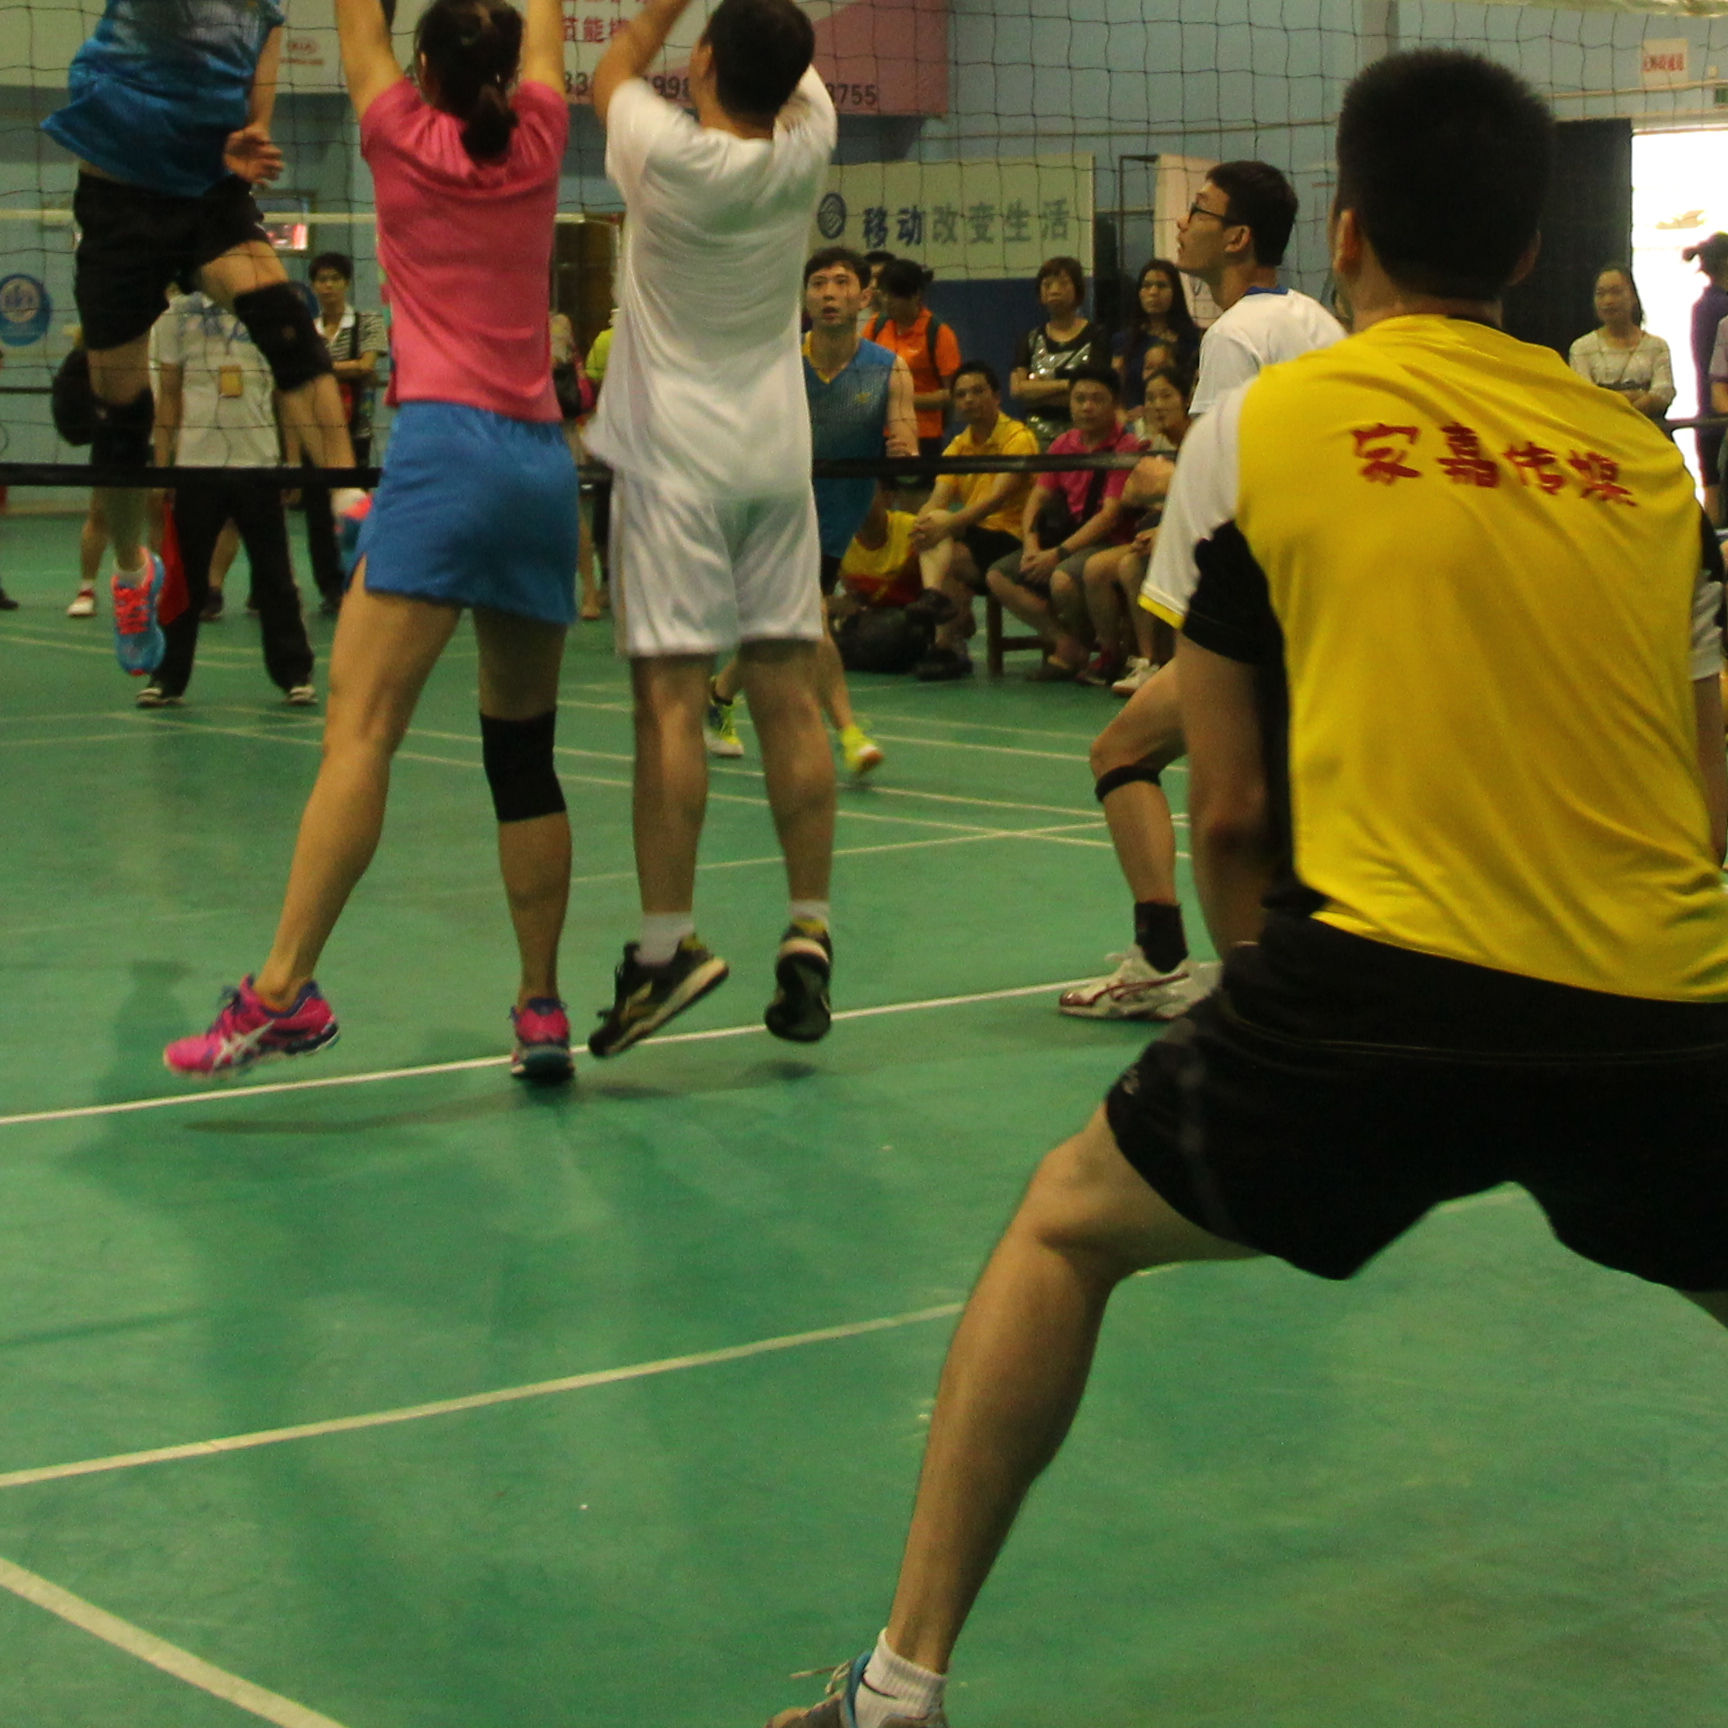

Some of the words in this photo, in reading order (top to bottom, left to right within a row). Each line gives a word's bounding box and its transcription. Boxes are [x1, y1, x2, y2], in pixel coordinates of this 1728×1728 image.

[862, 198, 1070, 248] 移动改变生活
